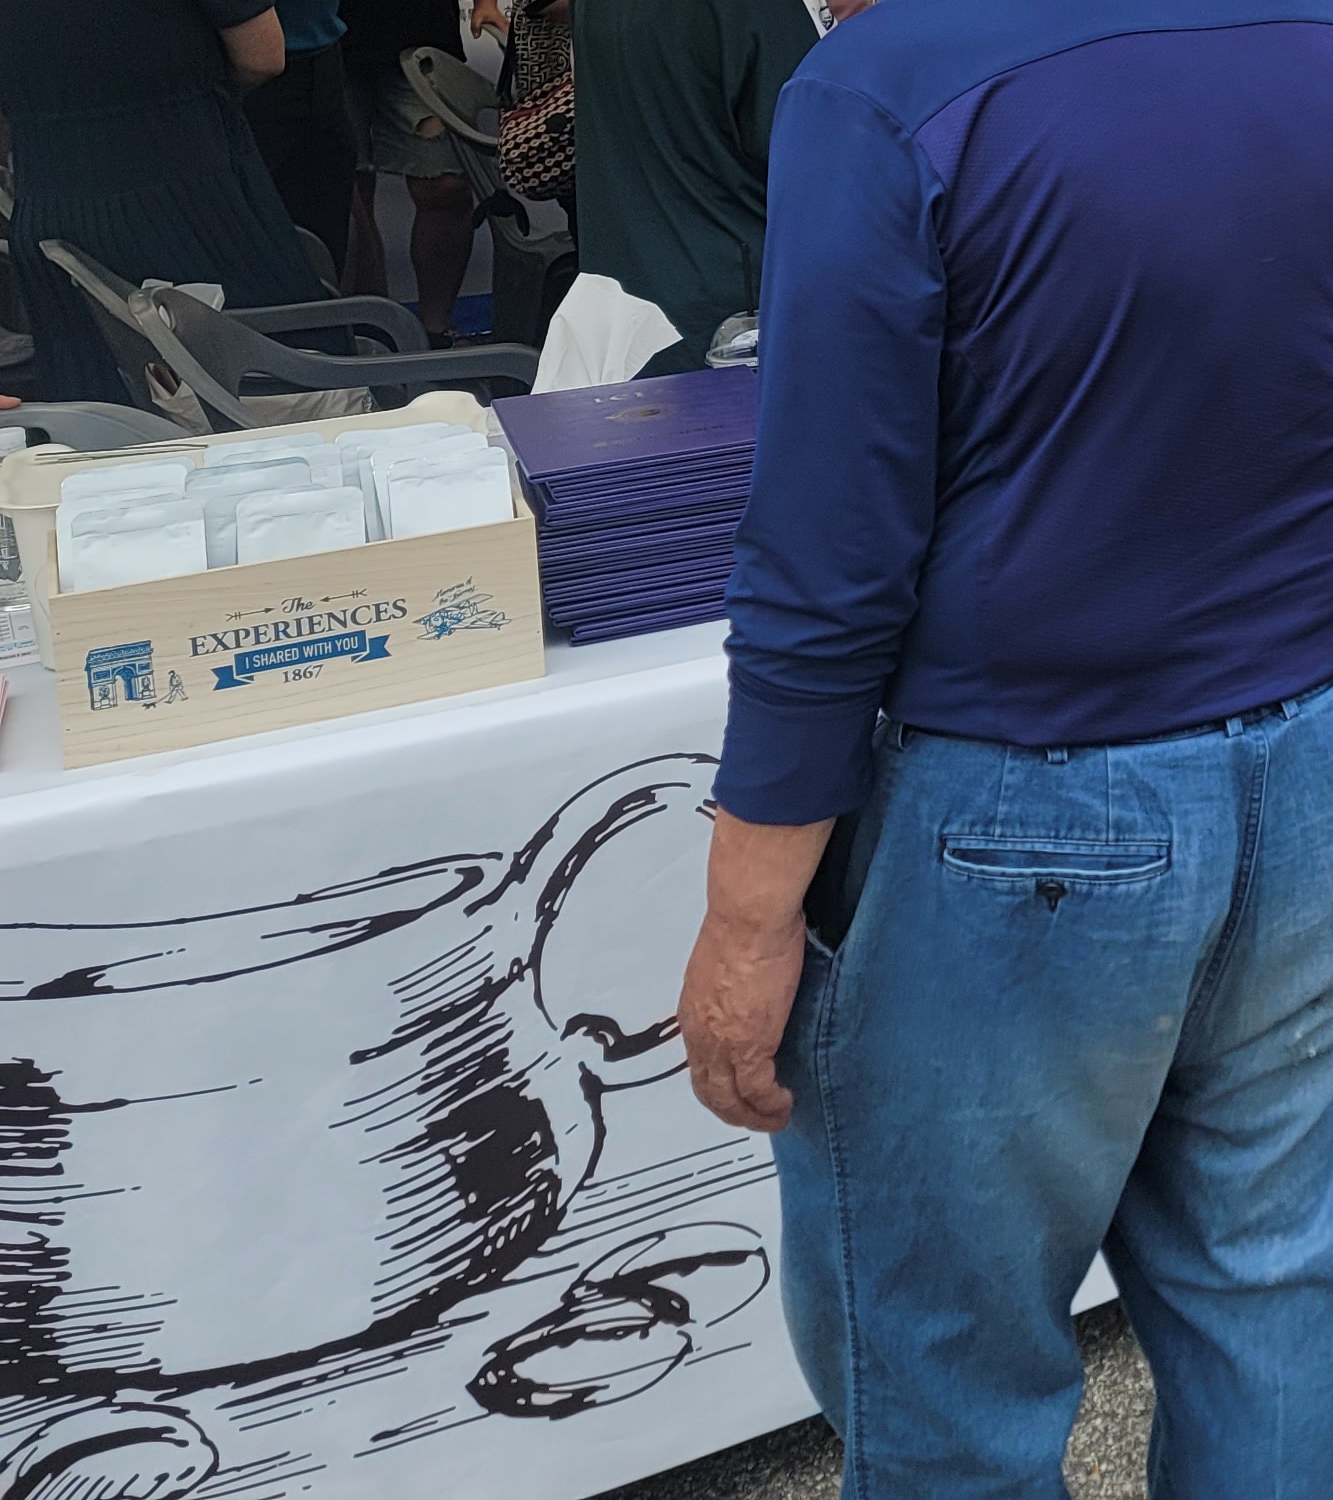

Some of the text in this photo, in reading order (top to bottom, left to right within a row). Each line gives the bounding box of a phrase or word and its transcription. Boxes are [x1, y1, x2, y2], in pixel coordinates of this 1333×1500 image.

[281, 597, 316, 614] The
[188, 598, 408, 658] EXPERIENCES
[245, 636, 359, 670] I SHARED WITH YOU
[283, 664, 324, 684] 1867
